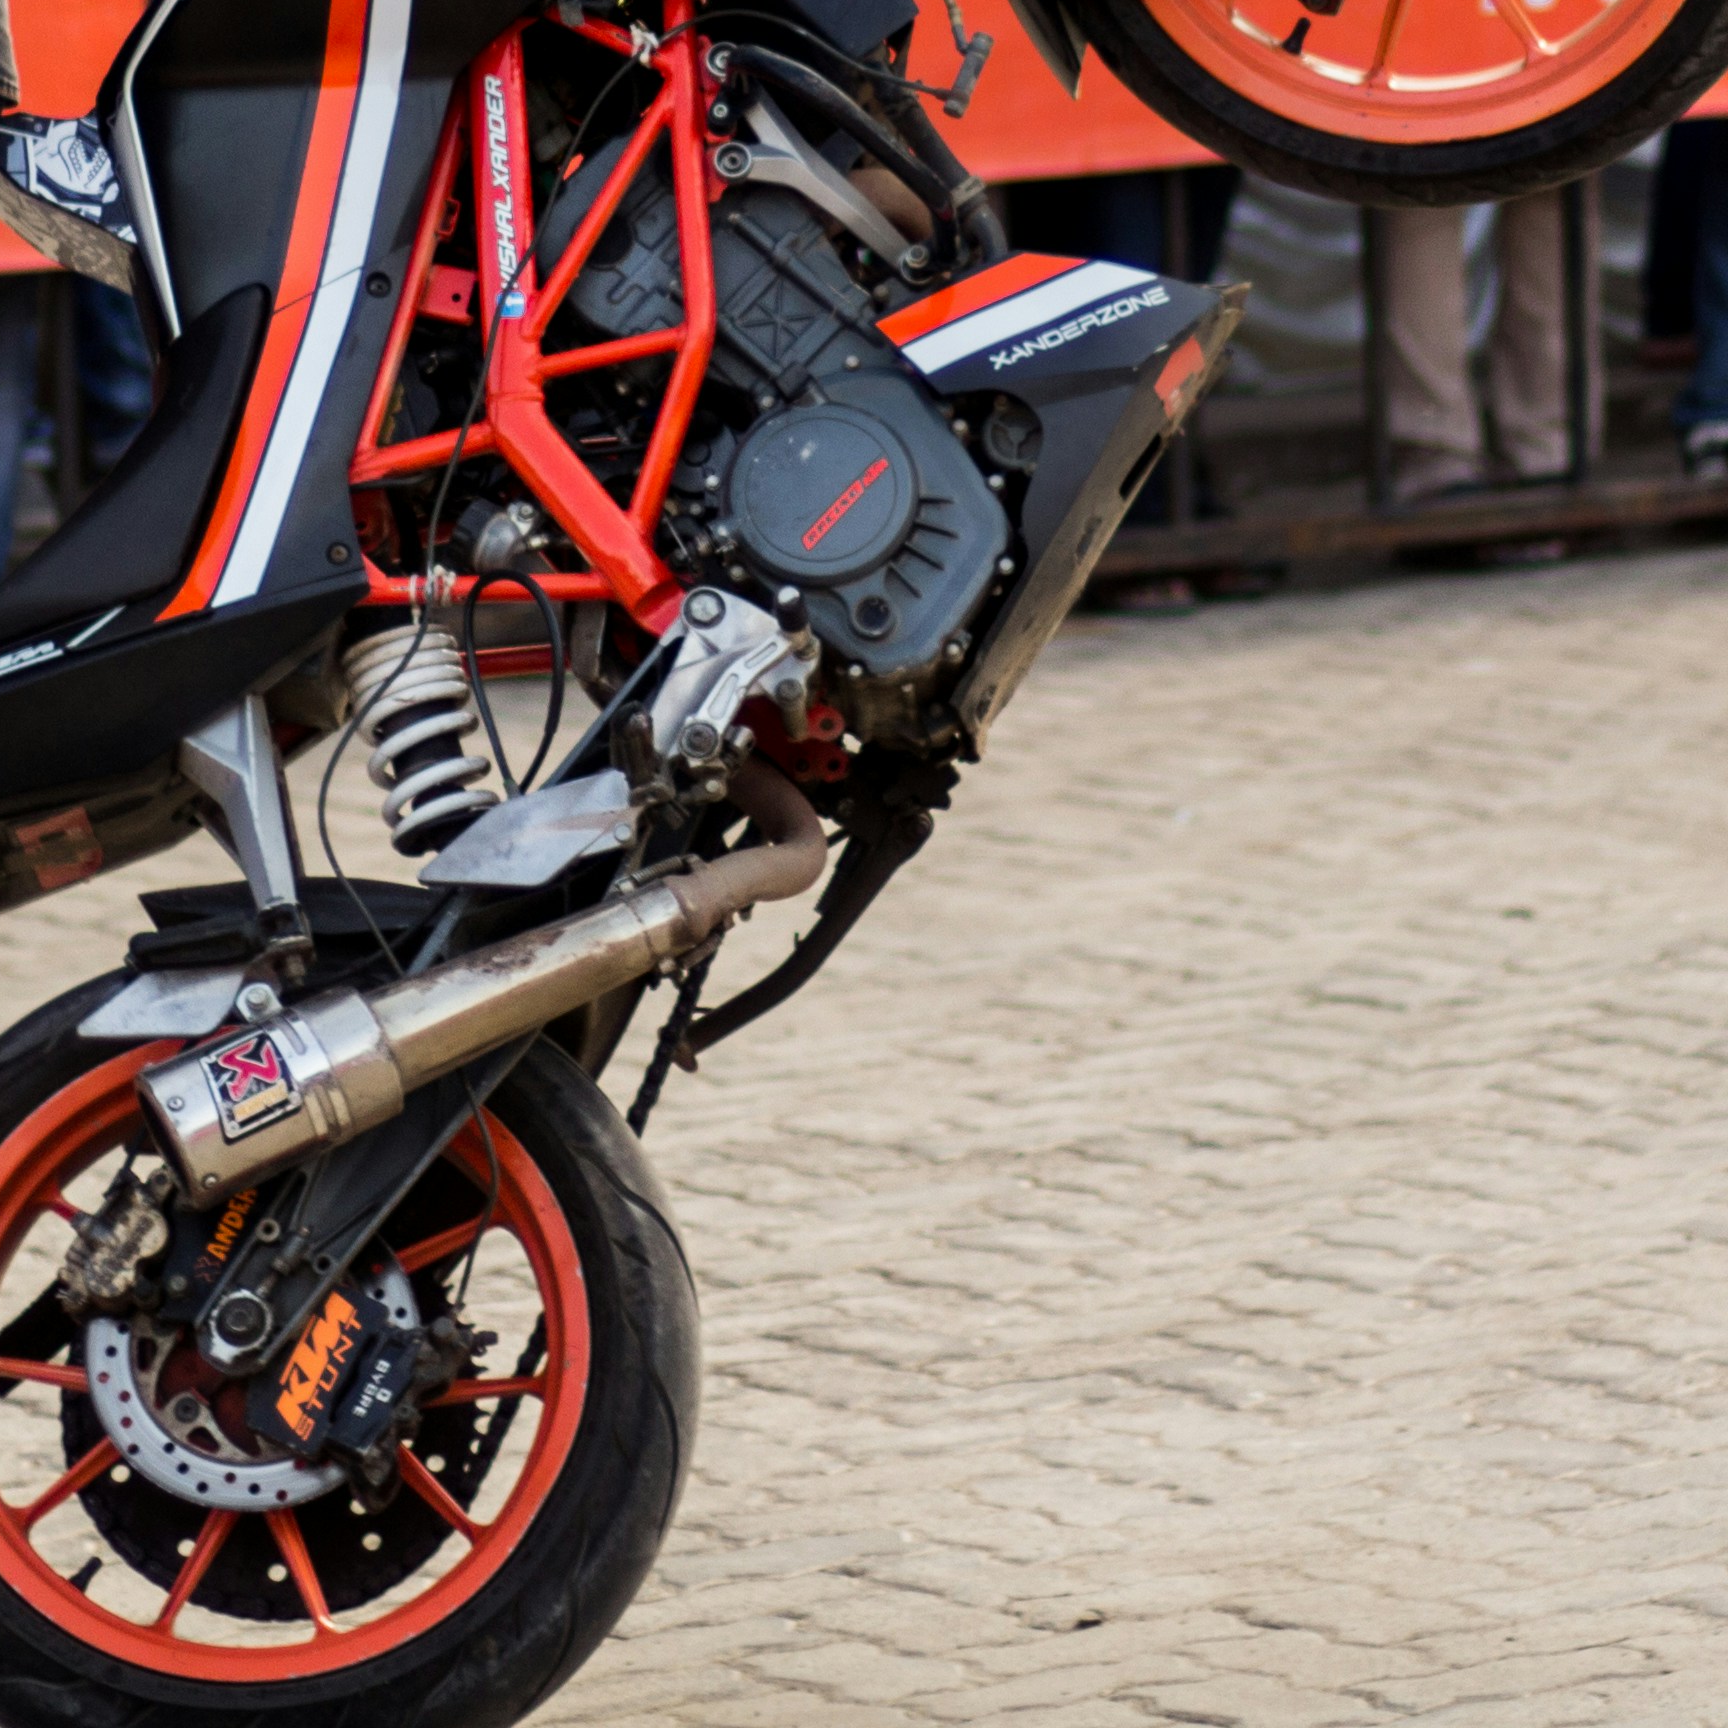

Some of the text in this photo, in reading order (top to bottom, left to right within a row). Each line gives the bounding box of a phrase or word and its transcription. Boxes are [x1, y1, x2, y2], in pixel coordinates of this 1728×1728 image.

[483, 74, 512, 193] XANDER
[989, 285, 1171, 371] XANDERZONE
[276, 1290, 359, 1430] KTM
[293, 1308, 363, 1441] STUNT
[352, 1359, 392, 1418] BYBRE
